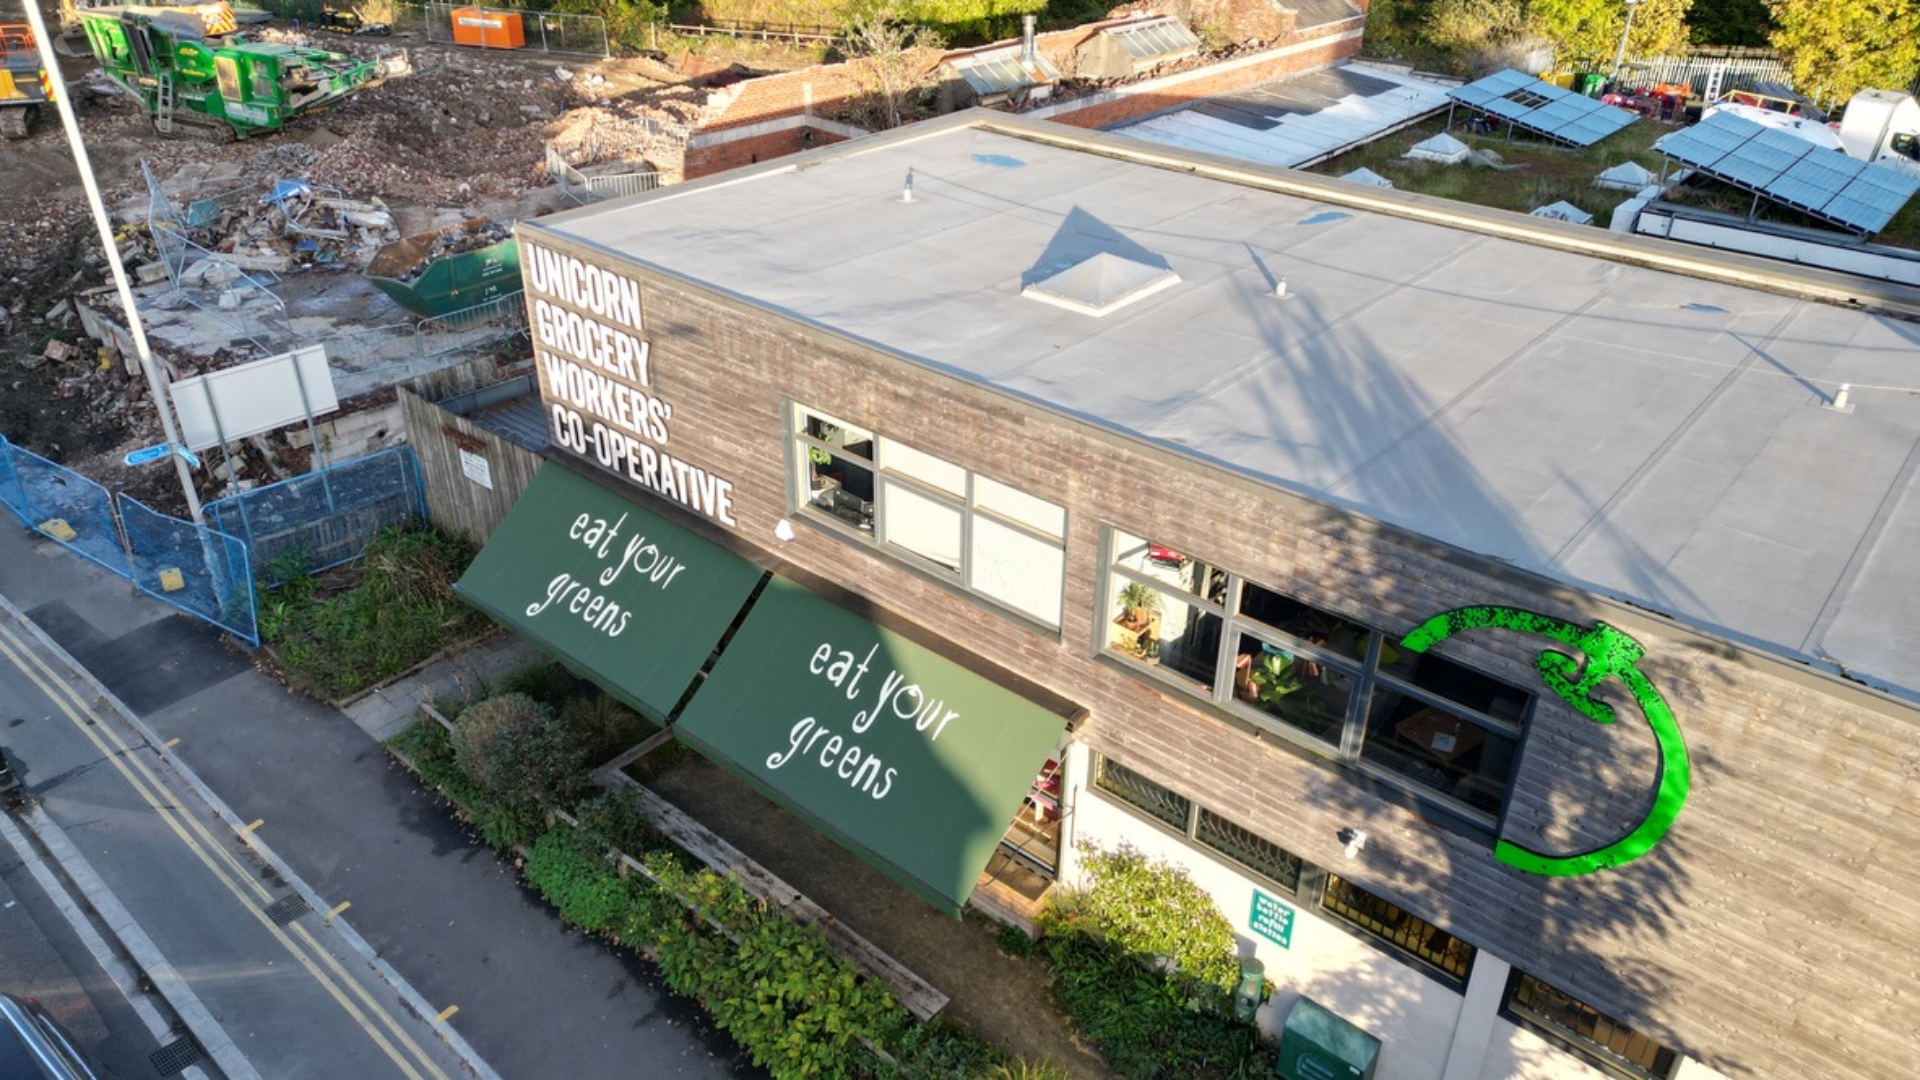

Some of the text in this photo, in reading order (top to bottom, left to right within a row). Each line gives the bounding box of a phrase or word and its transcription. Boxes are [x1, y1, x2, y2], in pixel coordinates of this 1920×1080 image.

[526, 243, 643, 331] UNICORN
[535, 299, 651, 387] GROCERY
[541, 351, 672, 446] WORKERS'
[552, 404, 736, 526] CO-OPERATIVE
[569, 511, 686, 590] eat your
[526, 573, 632, 637] greens
[809, 643, 960, 741] eat your
[766, 716, 898, 800] greens
[1256, 902, 1289, 926] bottle
[1258, 896, 1291, 917] water
[1258, 914, 1284, 933] refill
